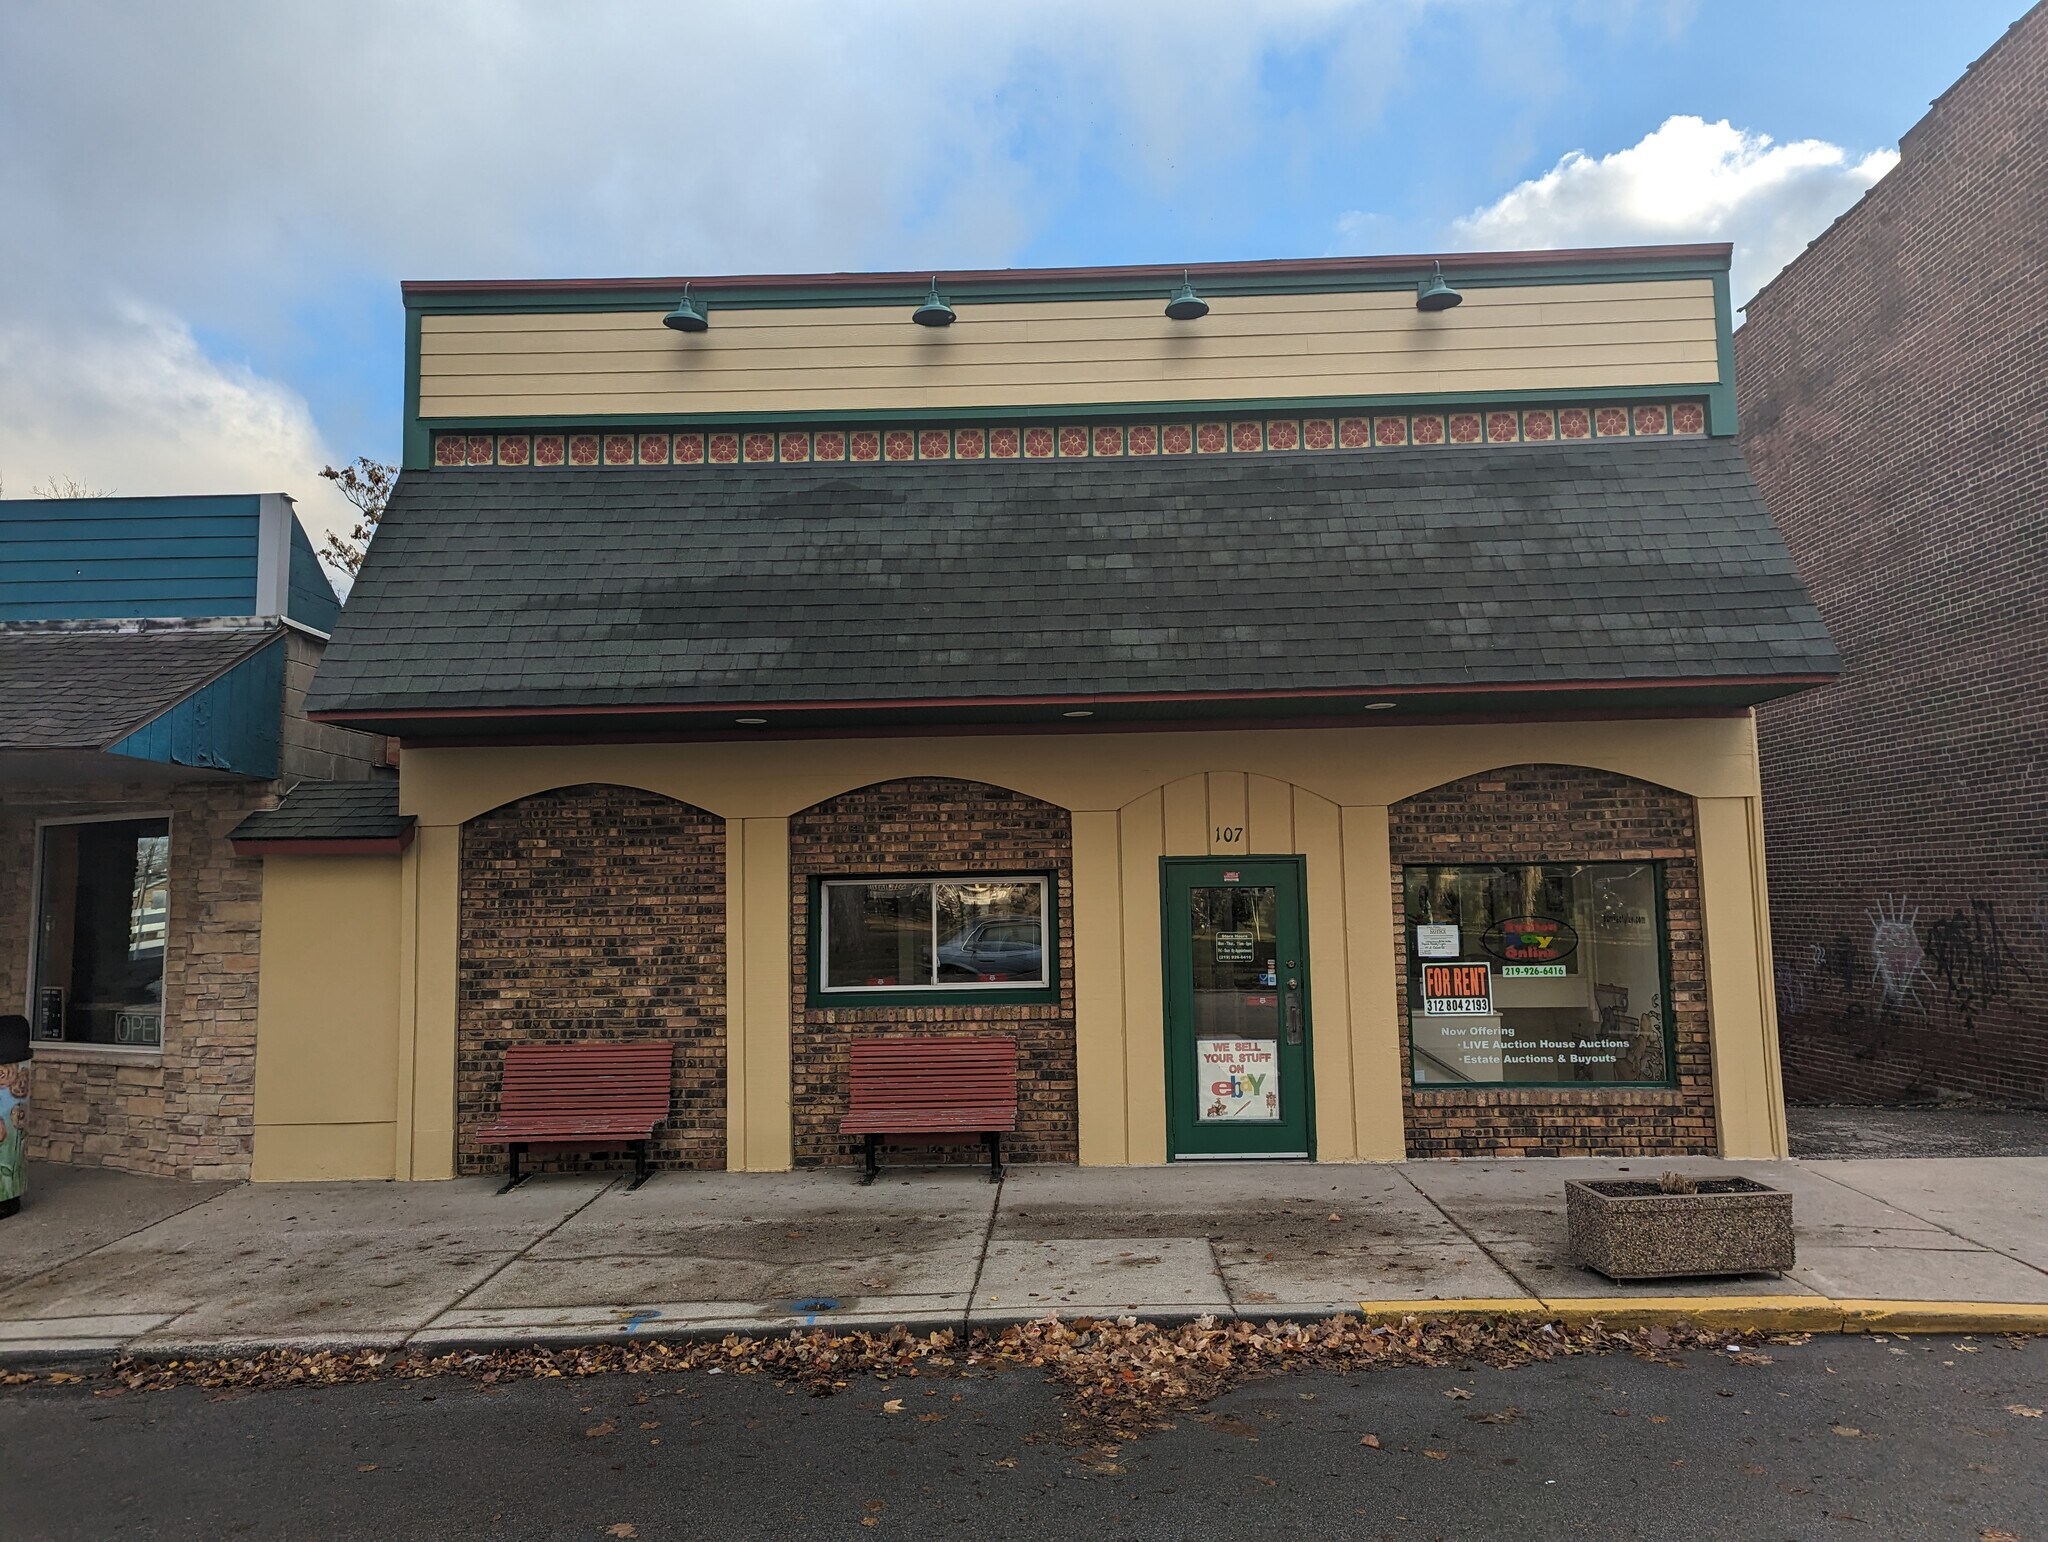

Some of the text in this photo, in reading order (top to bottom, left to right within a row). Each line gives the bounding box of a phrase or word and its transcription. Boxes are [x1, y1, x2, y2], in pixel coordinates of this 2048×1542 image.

[1216, 827, 1243, 843] 107
[1505, 967, 1564, 975] 219-926-6416
[1427, 967, 1486, 996] FOR RENT
[1427, 999, 1487, 1011] 312 804 2193
[1441, 1027, 1515, 1037] Now Offering
[1213, 1042, 1261, 1052] WE SELL
[1463, 1039, 1630, 1049] LIVE Auction House Auctions
[1204, 1053, 1271, 1063] YOUR STUFF
[1464, 1055, 1617, 1065] Estate Auctions & Buyouts
[1229, 1065, 1244, 1073] ON
